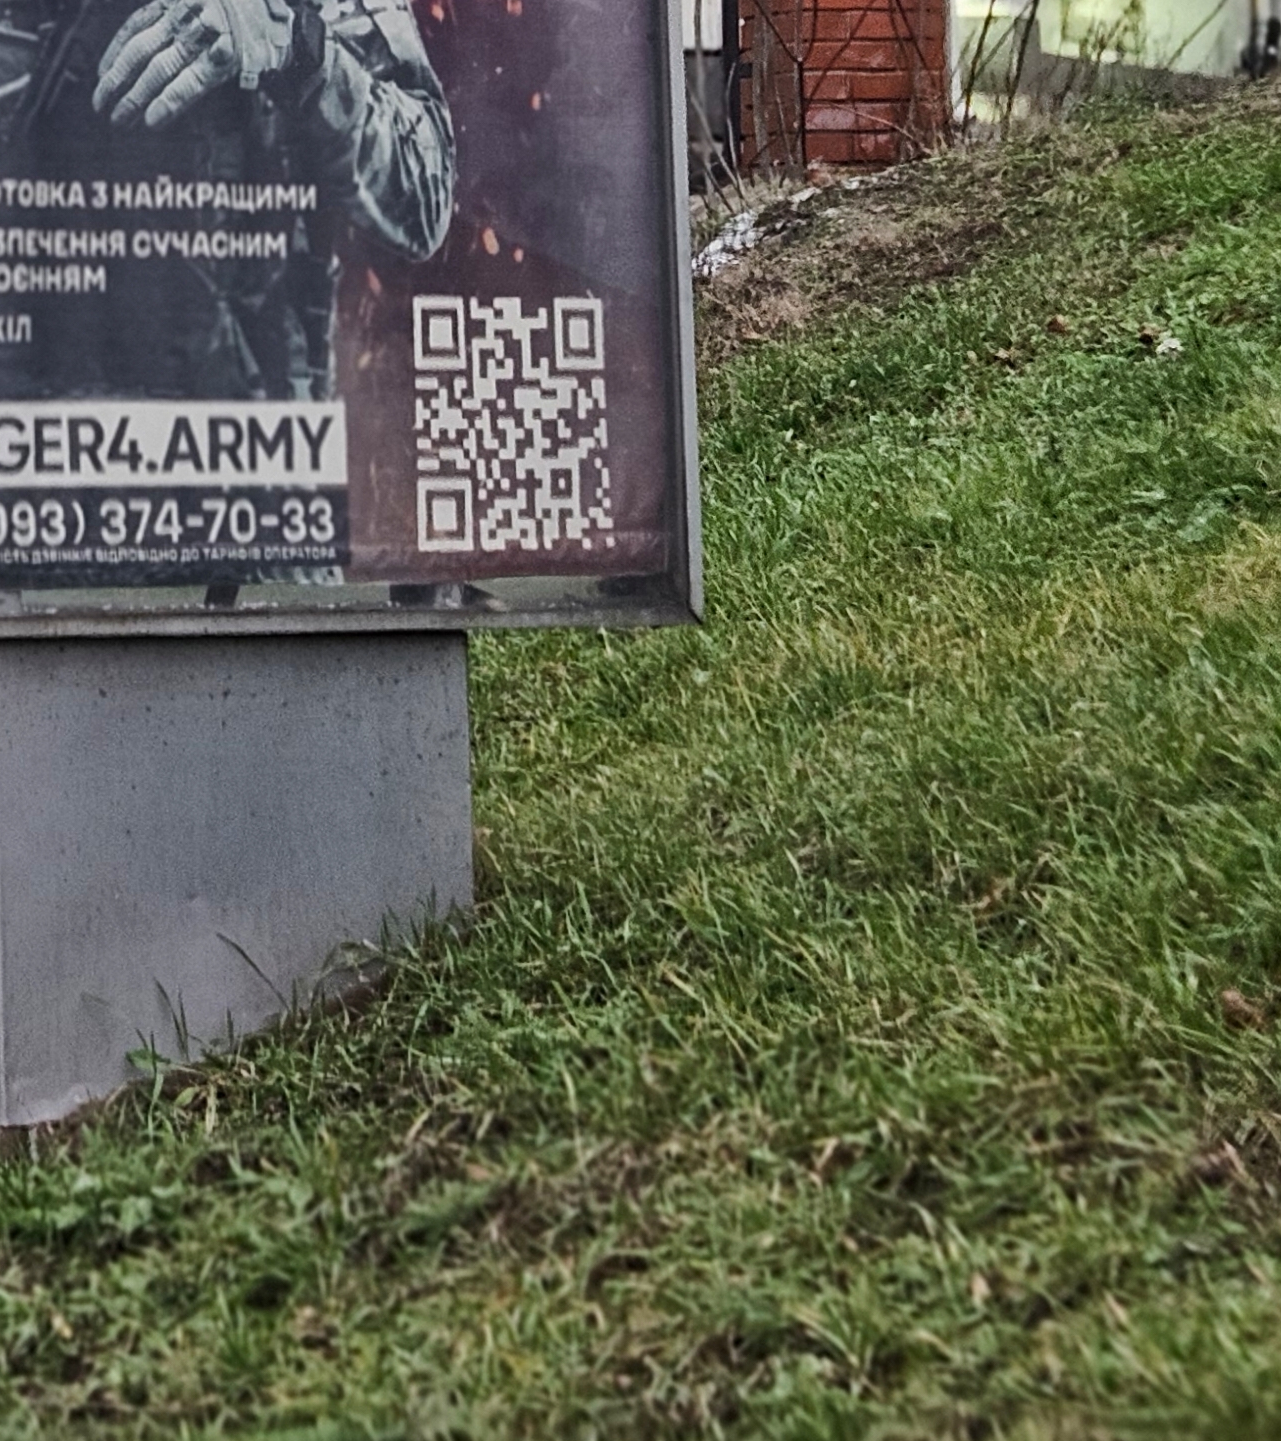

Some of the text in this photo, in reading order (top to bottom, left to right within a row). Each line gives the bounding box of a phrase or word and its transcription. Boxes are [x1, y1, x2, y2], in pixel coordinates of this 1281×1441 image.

[113, 177, 316, 213] НАЙКРАЩИМИ
[131, 229, 288, 259] СУЧАСНИМ
[100, 496, 336, 545] 374-70-33
